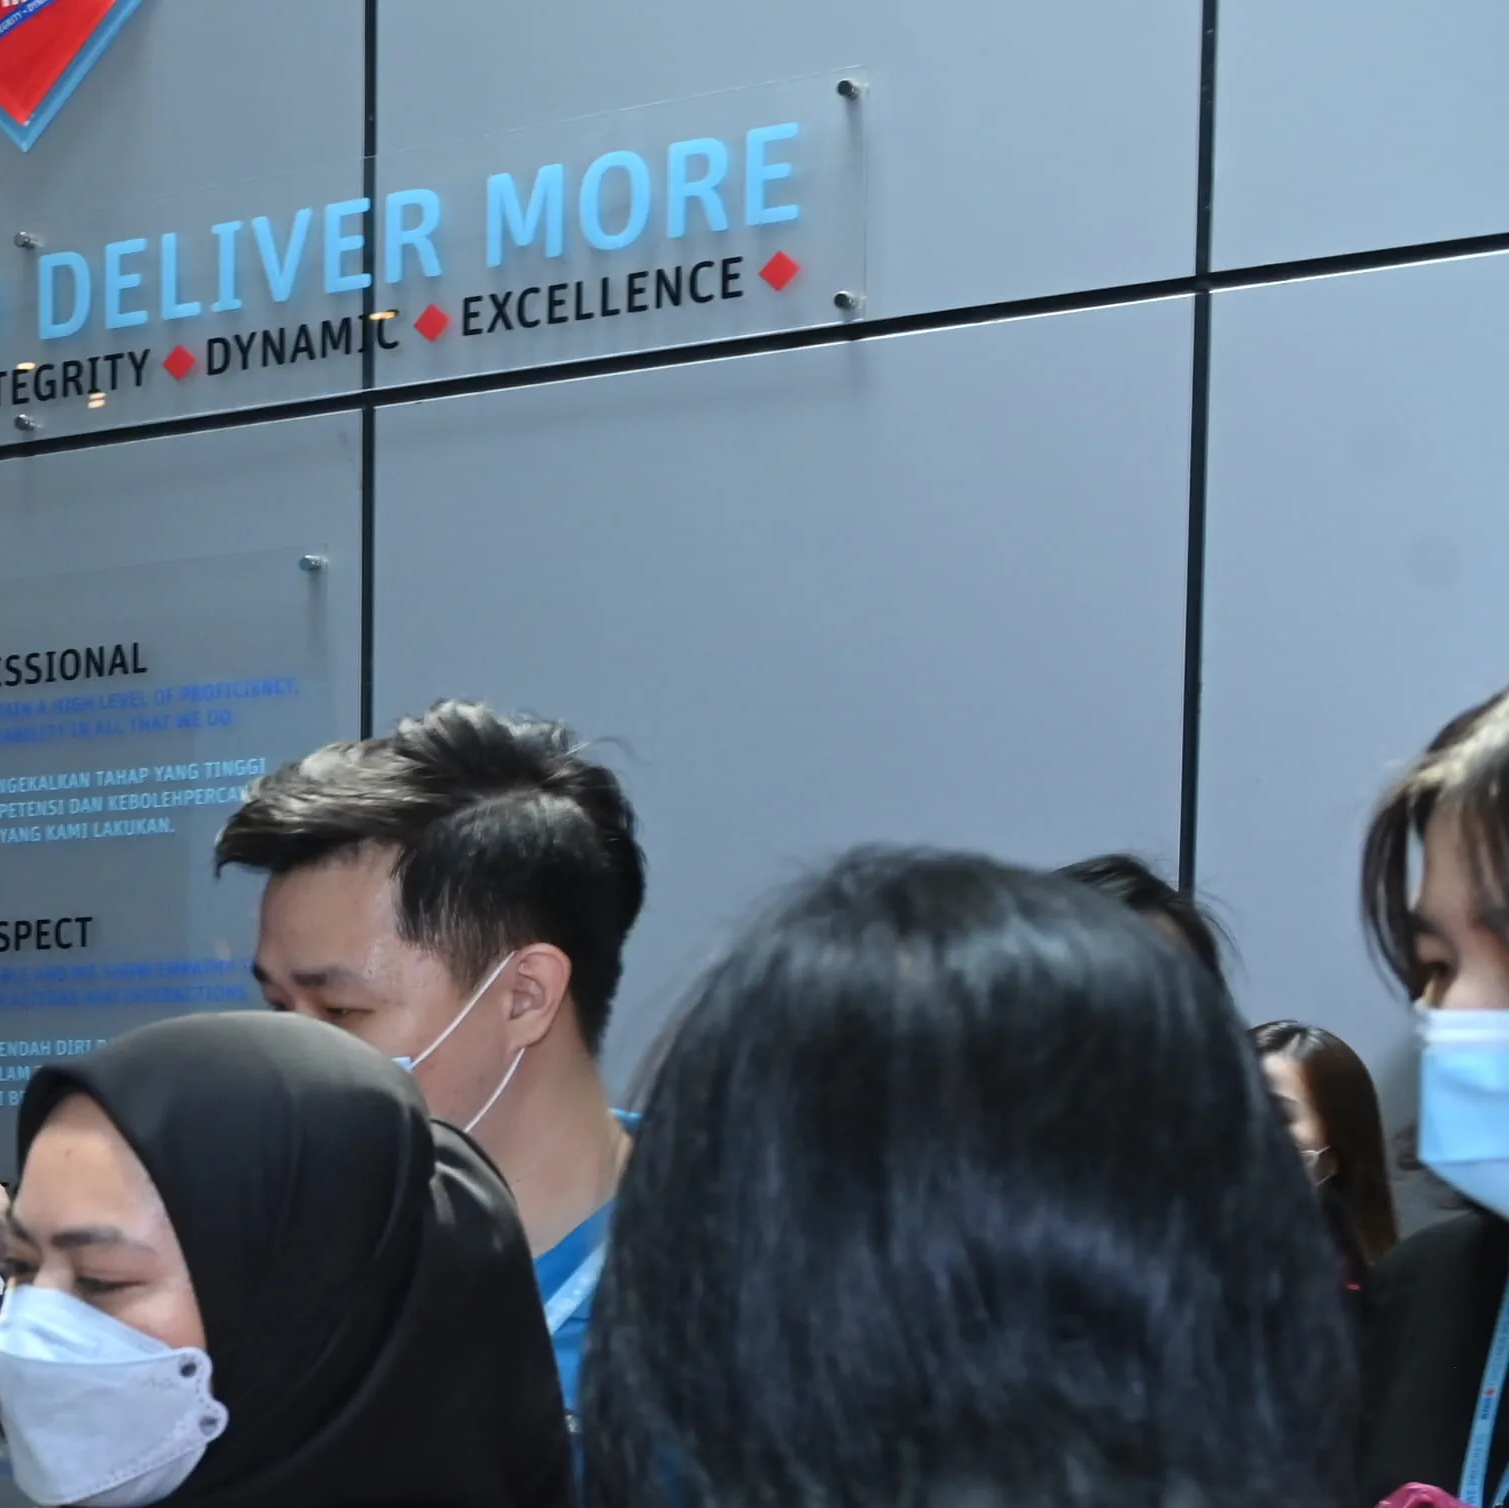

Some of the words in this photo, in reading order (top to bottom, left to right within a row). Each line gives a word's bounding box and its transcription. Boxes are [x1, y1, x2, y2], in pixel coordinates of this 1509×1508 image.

[37, 187, 444, 342] DELIVER
[485, 121, 801, 268] MORE
[206, 310, 401, 376] DYNAMIC
[462, 255, 744, 337] EXCELLENCE
[95, 767, 149, 787] TAHAP
[153, 763, 199, 782] YANG
[203, 757, 266, 779] TINGGI
[68, 796, 103, 815] DAN
[45, 822, 88, 841] KAMI
[92, 815, 176, 838] LAKUKAN.
[56, 1039, 91, 1056] DIRI
